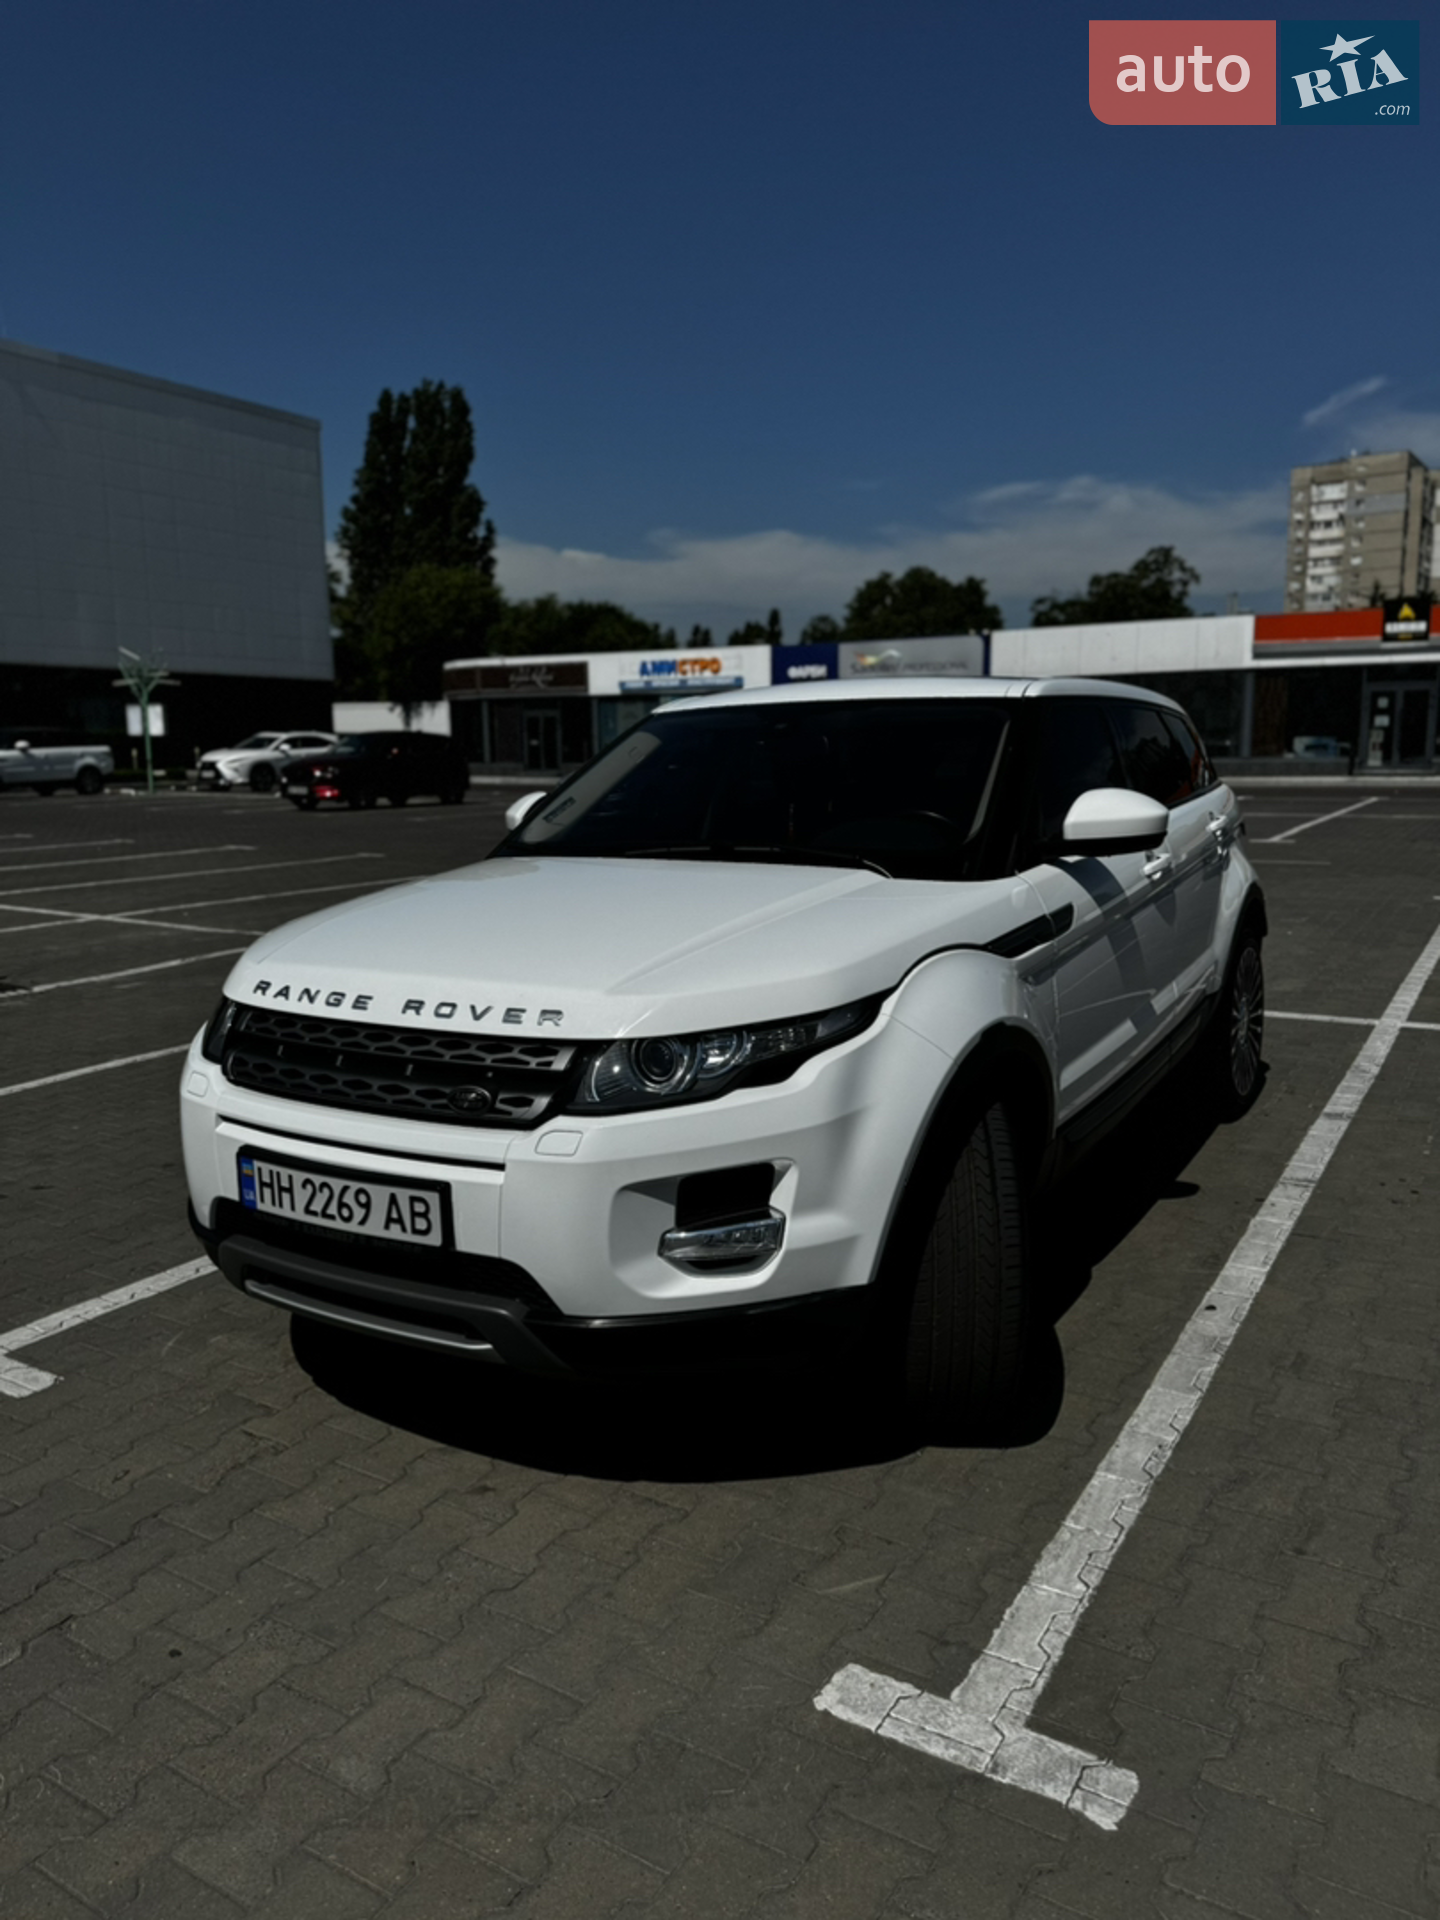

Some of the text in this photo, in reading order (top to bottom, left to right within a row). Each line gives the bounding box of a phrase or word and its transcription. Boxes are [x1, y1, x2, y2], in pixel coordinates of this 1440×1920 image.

[253, 979, 565, 1028] RANGE ROVER
[256, 1165, 297, 1213] HH
[301, 1178, 372, 1227] 2269
[383, 1192, 434, 1237] AB
